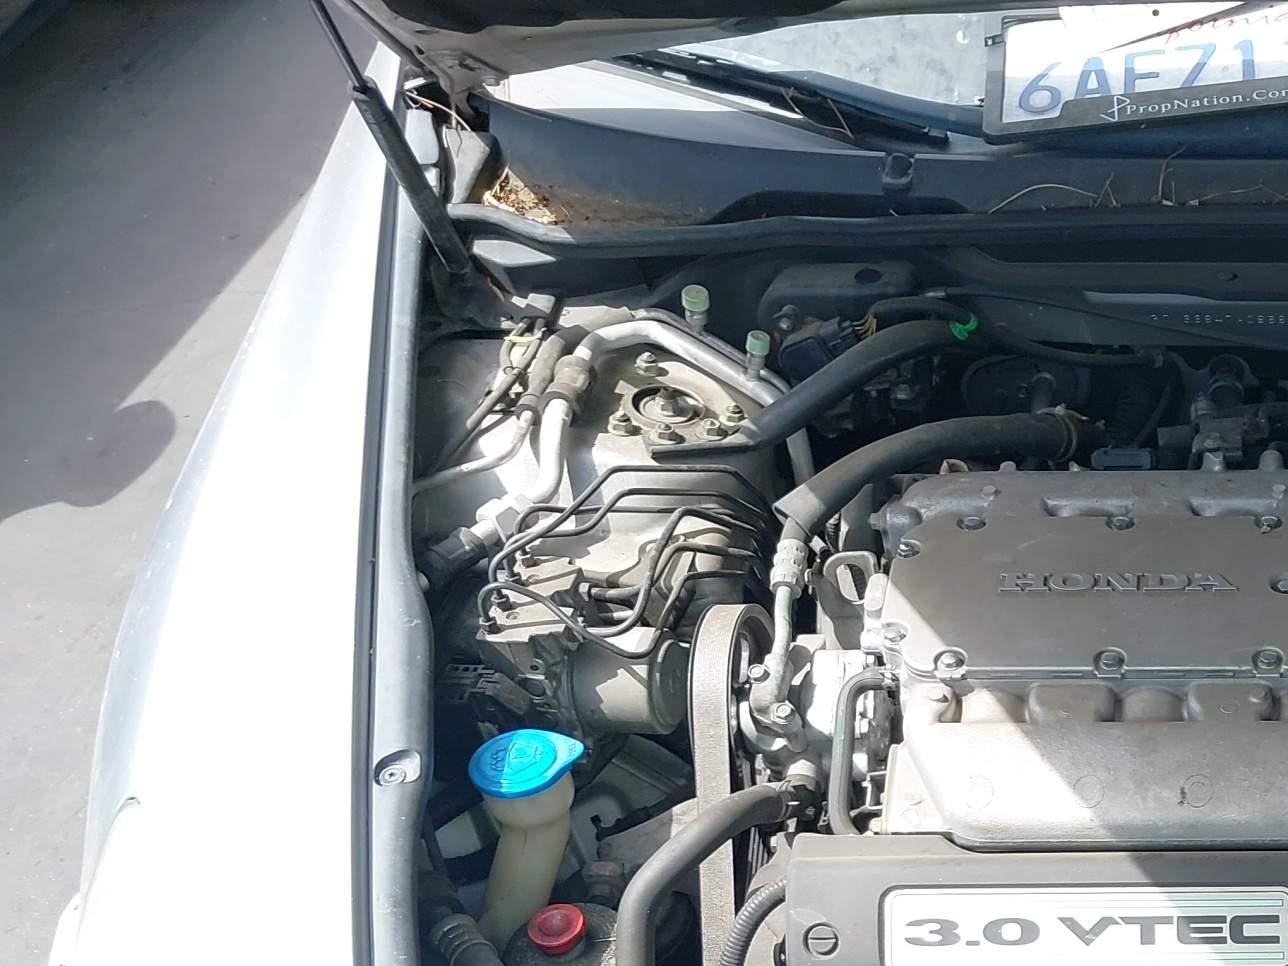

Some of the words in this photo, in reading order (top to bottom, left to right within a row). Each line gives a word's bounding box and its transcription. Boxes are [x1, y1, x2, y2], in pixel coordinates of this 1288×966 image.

[998, 571, 1240, 593] HONDA
[904, 916, 1040, 947] 3.0
[1057, 913, 1281, 947] VTEC
